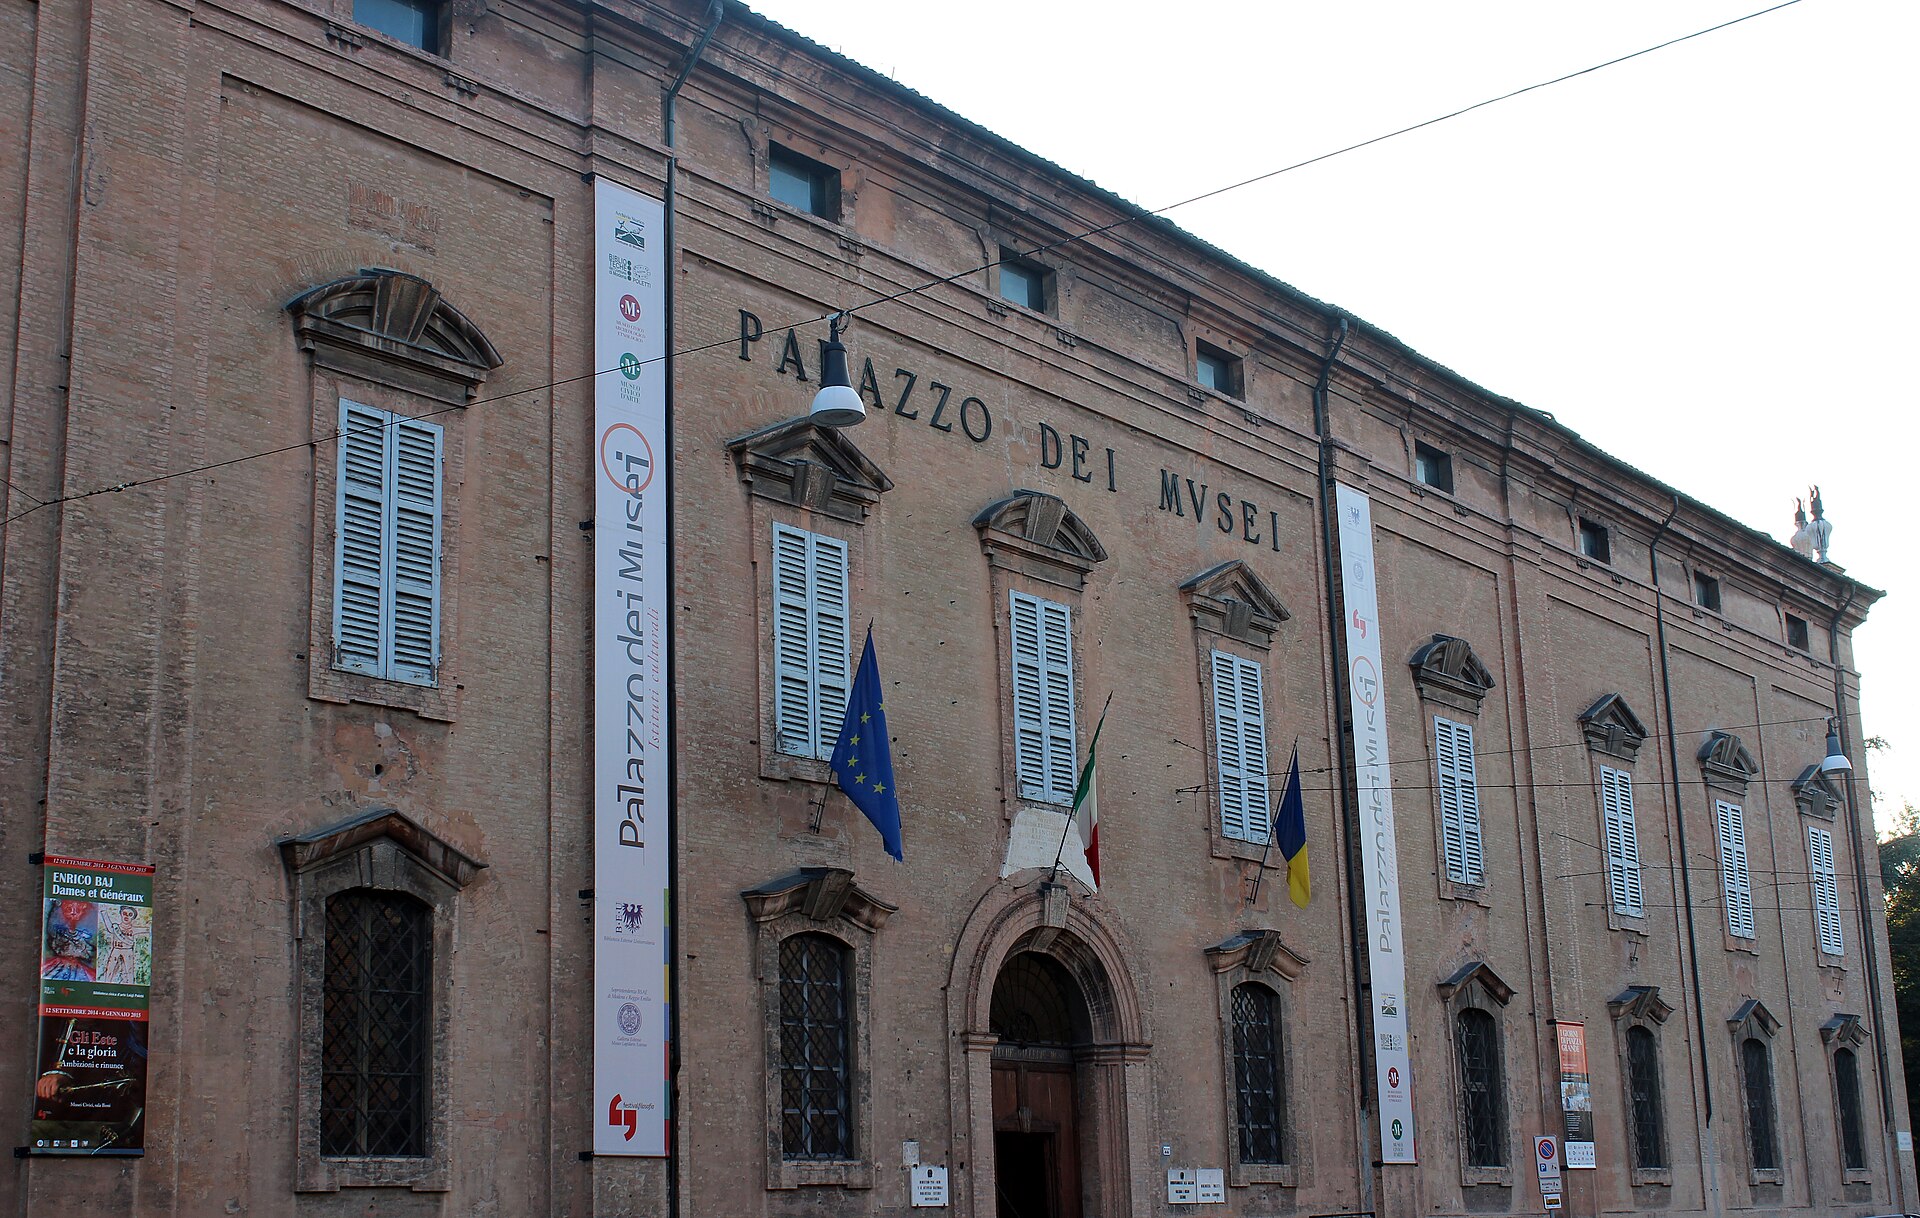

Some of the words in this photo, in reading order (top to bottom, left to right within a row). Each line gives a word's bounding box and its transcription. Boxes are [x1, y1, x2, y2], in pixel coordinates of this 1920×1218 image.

[609, 253, 627, 264] BIBLIO
[609, 259, 627, 271] TECHE
[632, 277, 652, 288] POLETTI
[624, 299, 636, 317] M
[620, 380, 641, 391] MUSEO
[738, 309, 992, 443] PAAZZO
[1038, 422, 1117, 492] DEI
[1158, 468, 1280, 552] MVSEI
[615, 450, 650, 583] Musei
[616, 589, 644, 666] dei
[646, 606, 660, 683] culturali
[648, 688, 660, 751] Istituti
[1359, 675, 1380, 768] Musei
[616, 673, 645, 849] Palazzo
[1367, 774, 1384, 827] dei
[59, 859, 92, 867] SETTEMBRE
[53, 872, 92, 886] ENRICO
[95, 876, 114, 888] BAJ
[52, 884, 86, 898] Dames
[88, 888, 98, 898] et
[100, 888, 145, 903] Généraux
[1374, 832, 1393, 954] Palazzo
[69, 1030, 90, 1045] Gli
[91, 1031, 118, 1046] Este
[1562, 1029, 1578, 1038] GIORNI
[1566, 1037, 1584, 1046] PIAZZA
[68, 1047, 74, 1055] e
[76, 1044, 86, 1056] la
[87, 1045, 117, 1059] gloria
[1561, 1044, 1580, 1053] GRANDE
[60, 1060, 95, 1069] Ambizioni
[100, 1061, 124, 1070] rinunce
[1390, 1071, 1398, 1084] M
